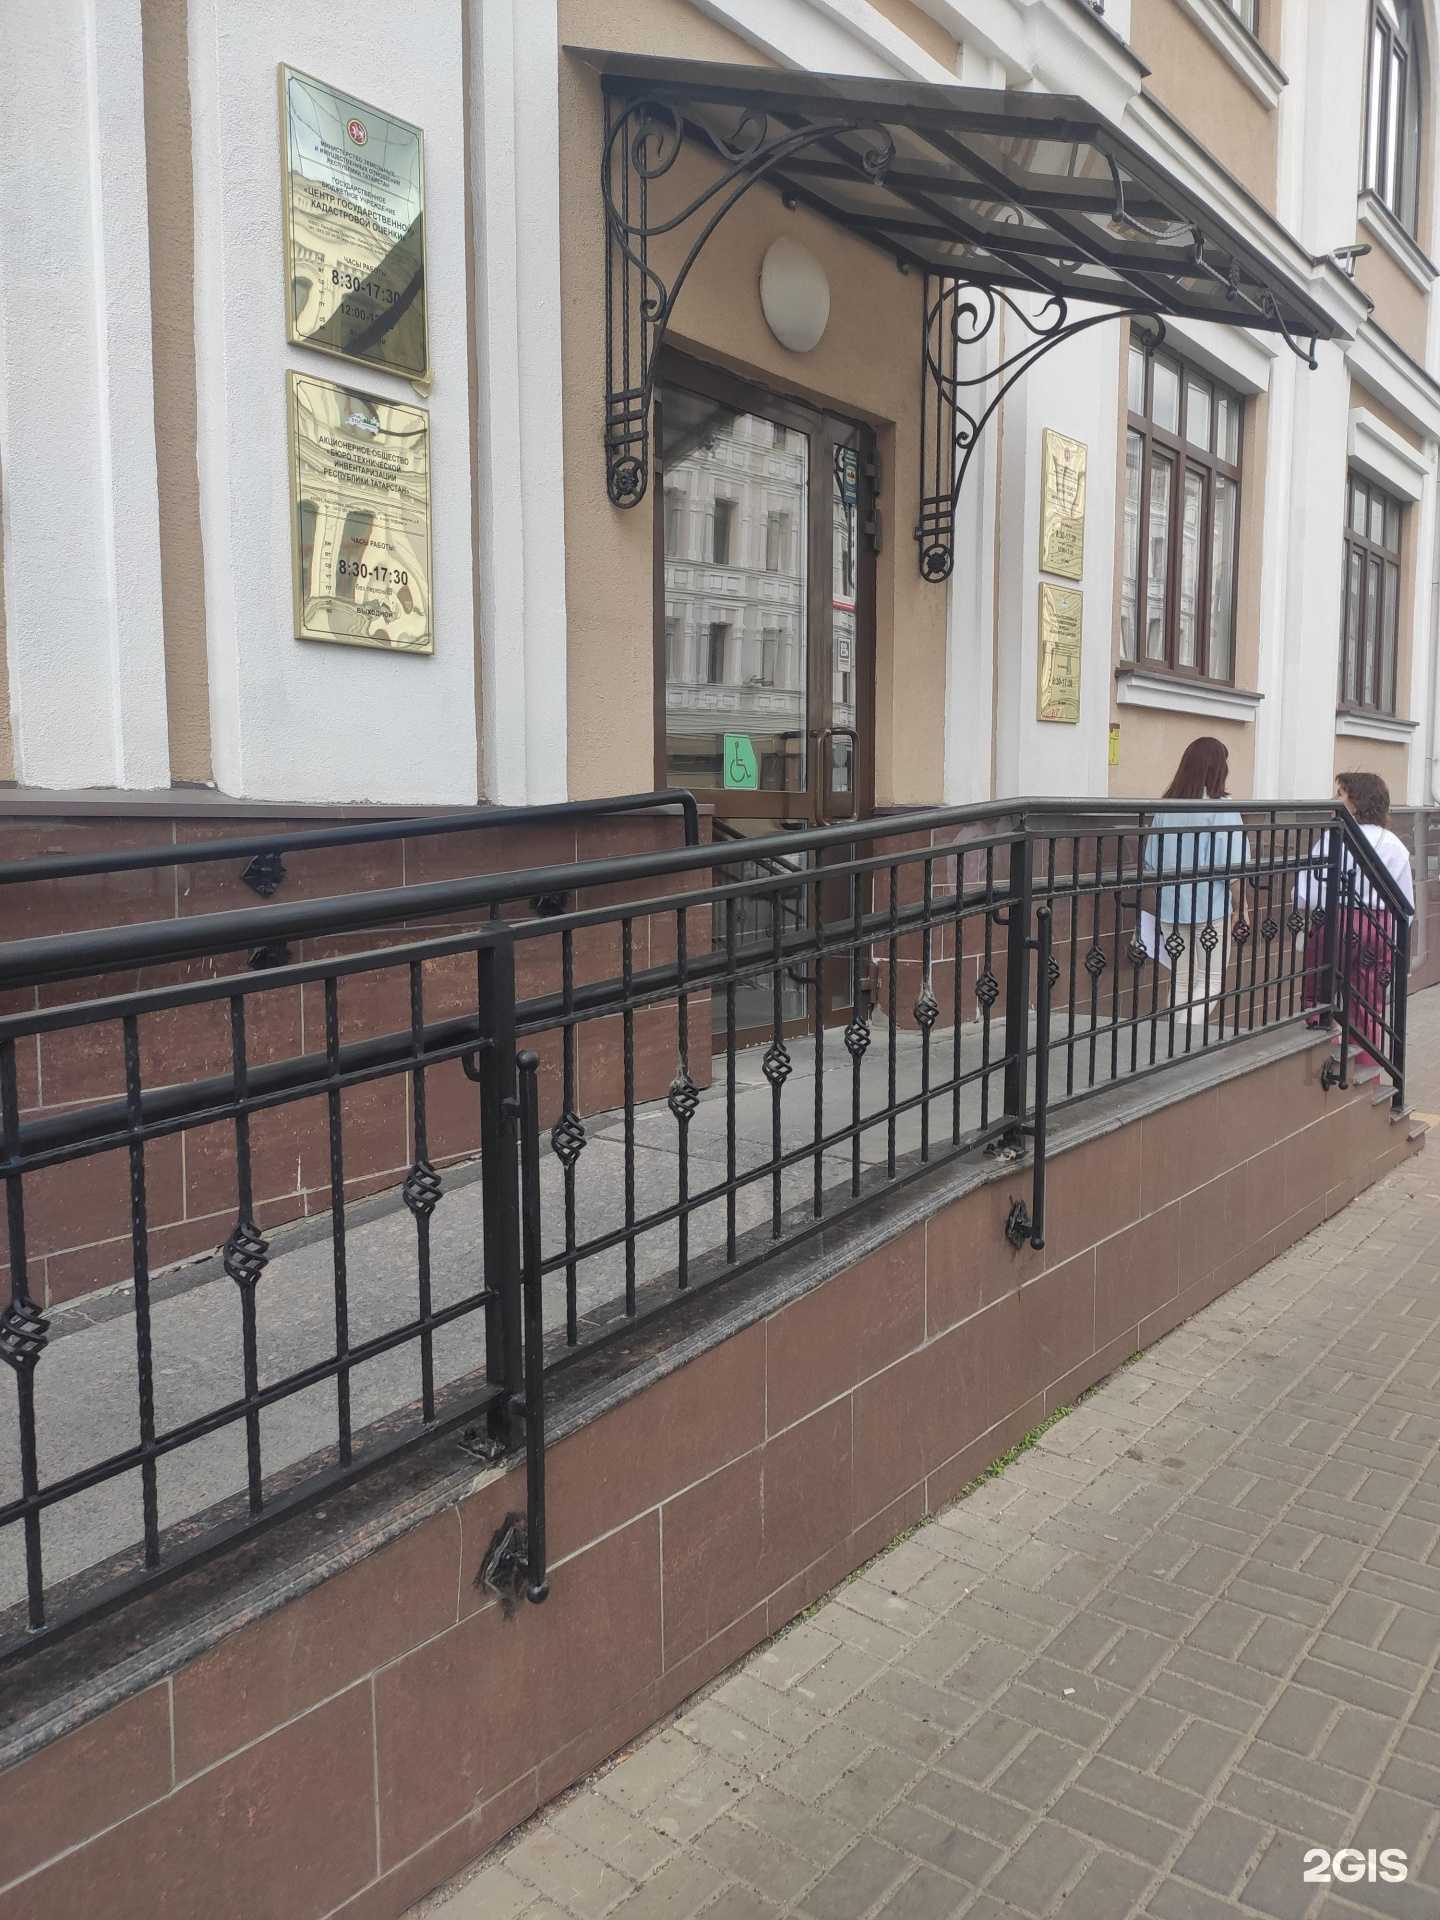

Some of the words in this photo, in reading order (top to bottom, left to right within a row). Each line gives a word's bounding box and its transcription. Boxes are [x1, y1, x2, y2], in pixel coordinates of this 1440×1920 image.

[303, 187, 335, 203] «ЦЕНТР
[311, 199, 371, 228] КАДАСТРОВОЙ
[344, 256, 362, 269] ЧАСЫ
[332, 269, 401, 305] 8:30-17:30
[318, 435, 371, 456] АКЦИОНЕРНОЕ
[371, 449, 409, 466] ОБЩЕСТВО
[334, 460, 397, 481] ИНВЕНТАРИЗАЦИИ
[353, 454, 401, 473] ТЕХНИЧЕСКОЙ
[323, 468, 370, 487] РЕСПУБЛИКИ
[339, 559, 408, 586] 8:30-17:30
